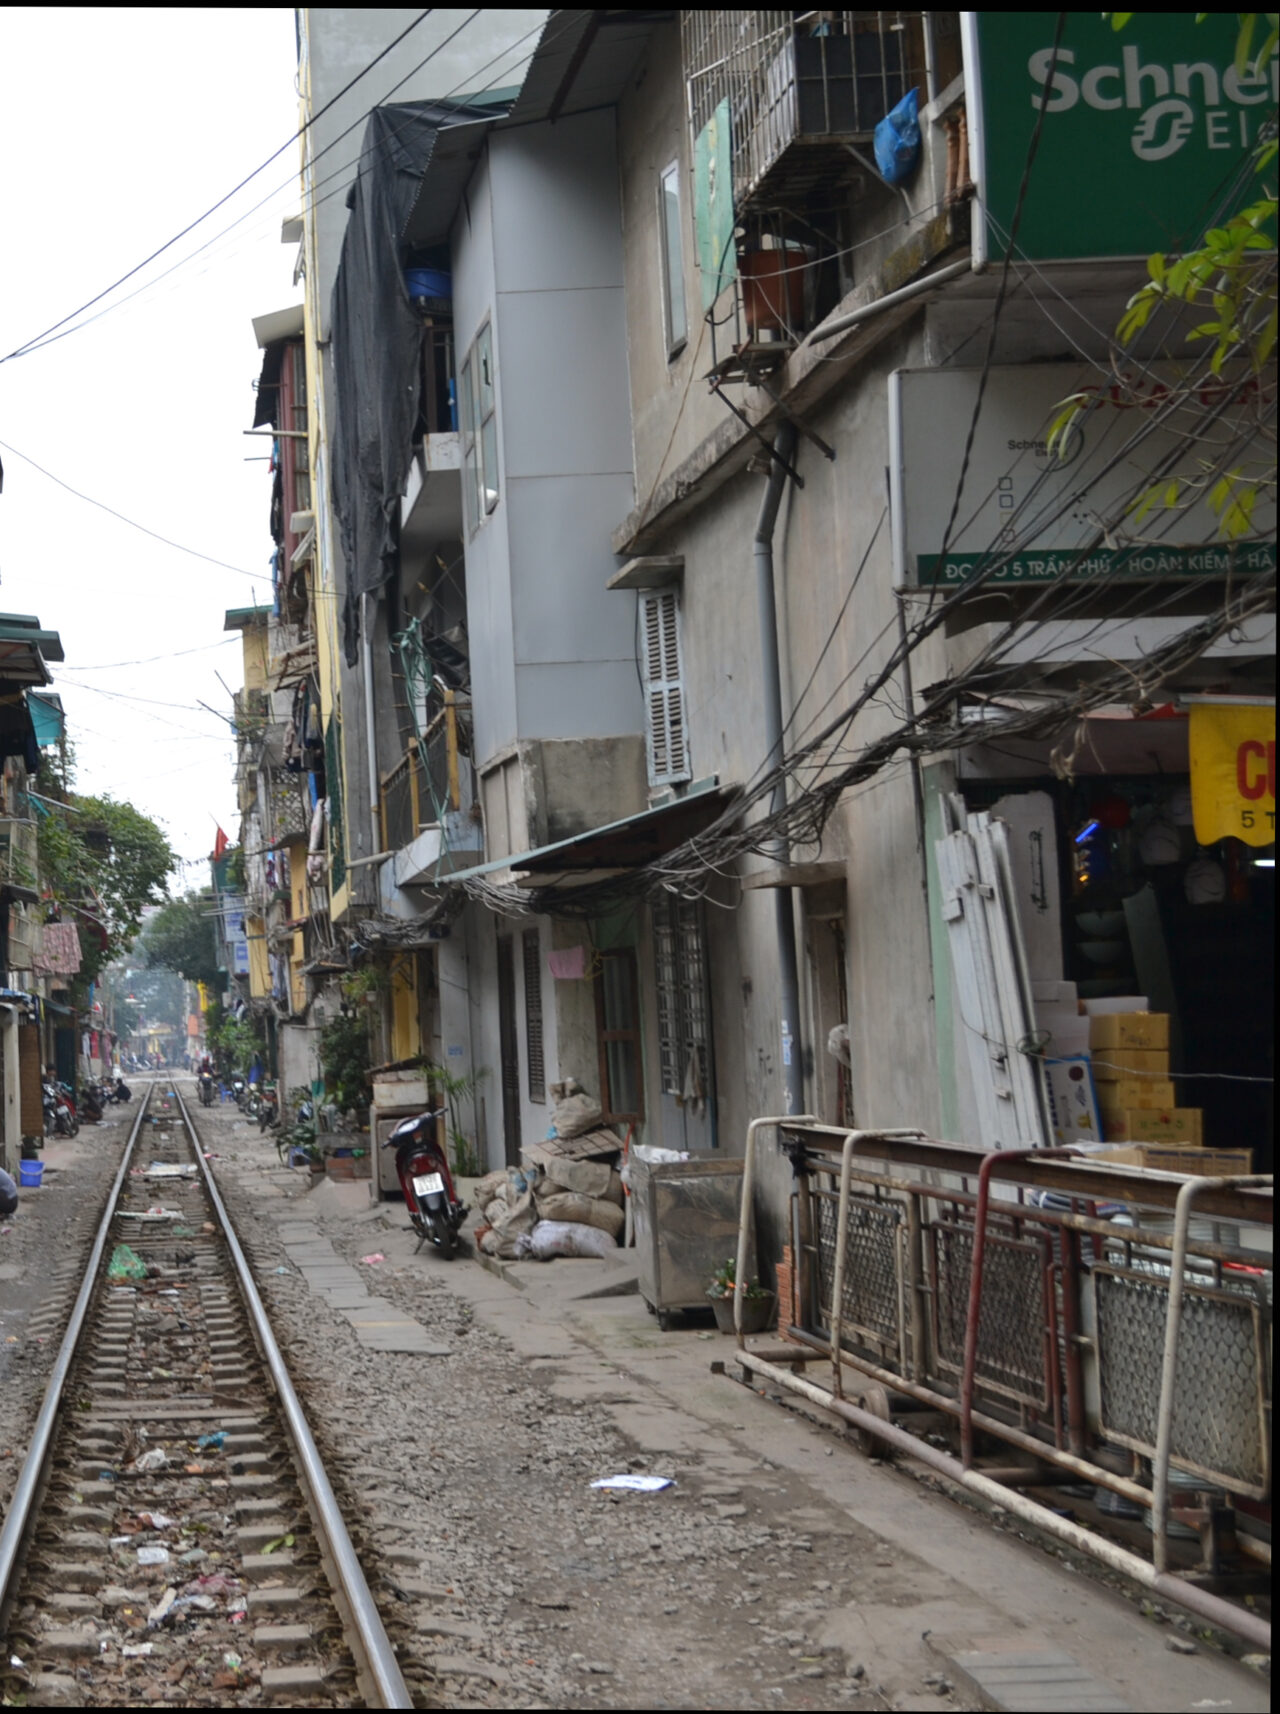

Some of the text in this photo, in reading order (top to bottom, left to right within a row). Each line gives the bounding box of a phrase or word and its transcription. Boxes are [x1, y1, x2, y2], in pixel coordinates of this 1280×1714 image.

[1012, 561, 1024, 577] 5
[1026, 554, 1071, 577] TRẦN
[1077, 553, 1111, 574] PHÚ
[1128, 551, 1183, 573] HOÀN
[1187, 549, 1231, 570] KIẾM
[1241, 810, 1255, 829] 5
